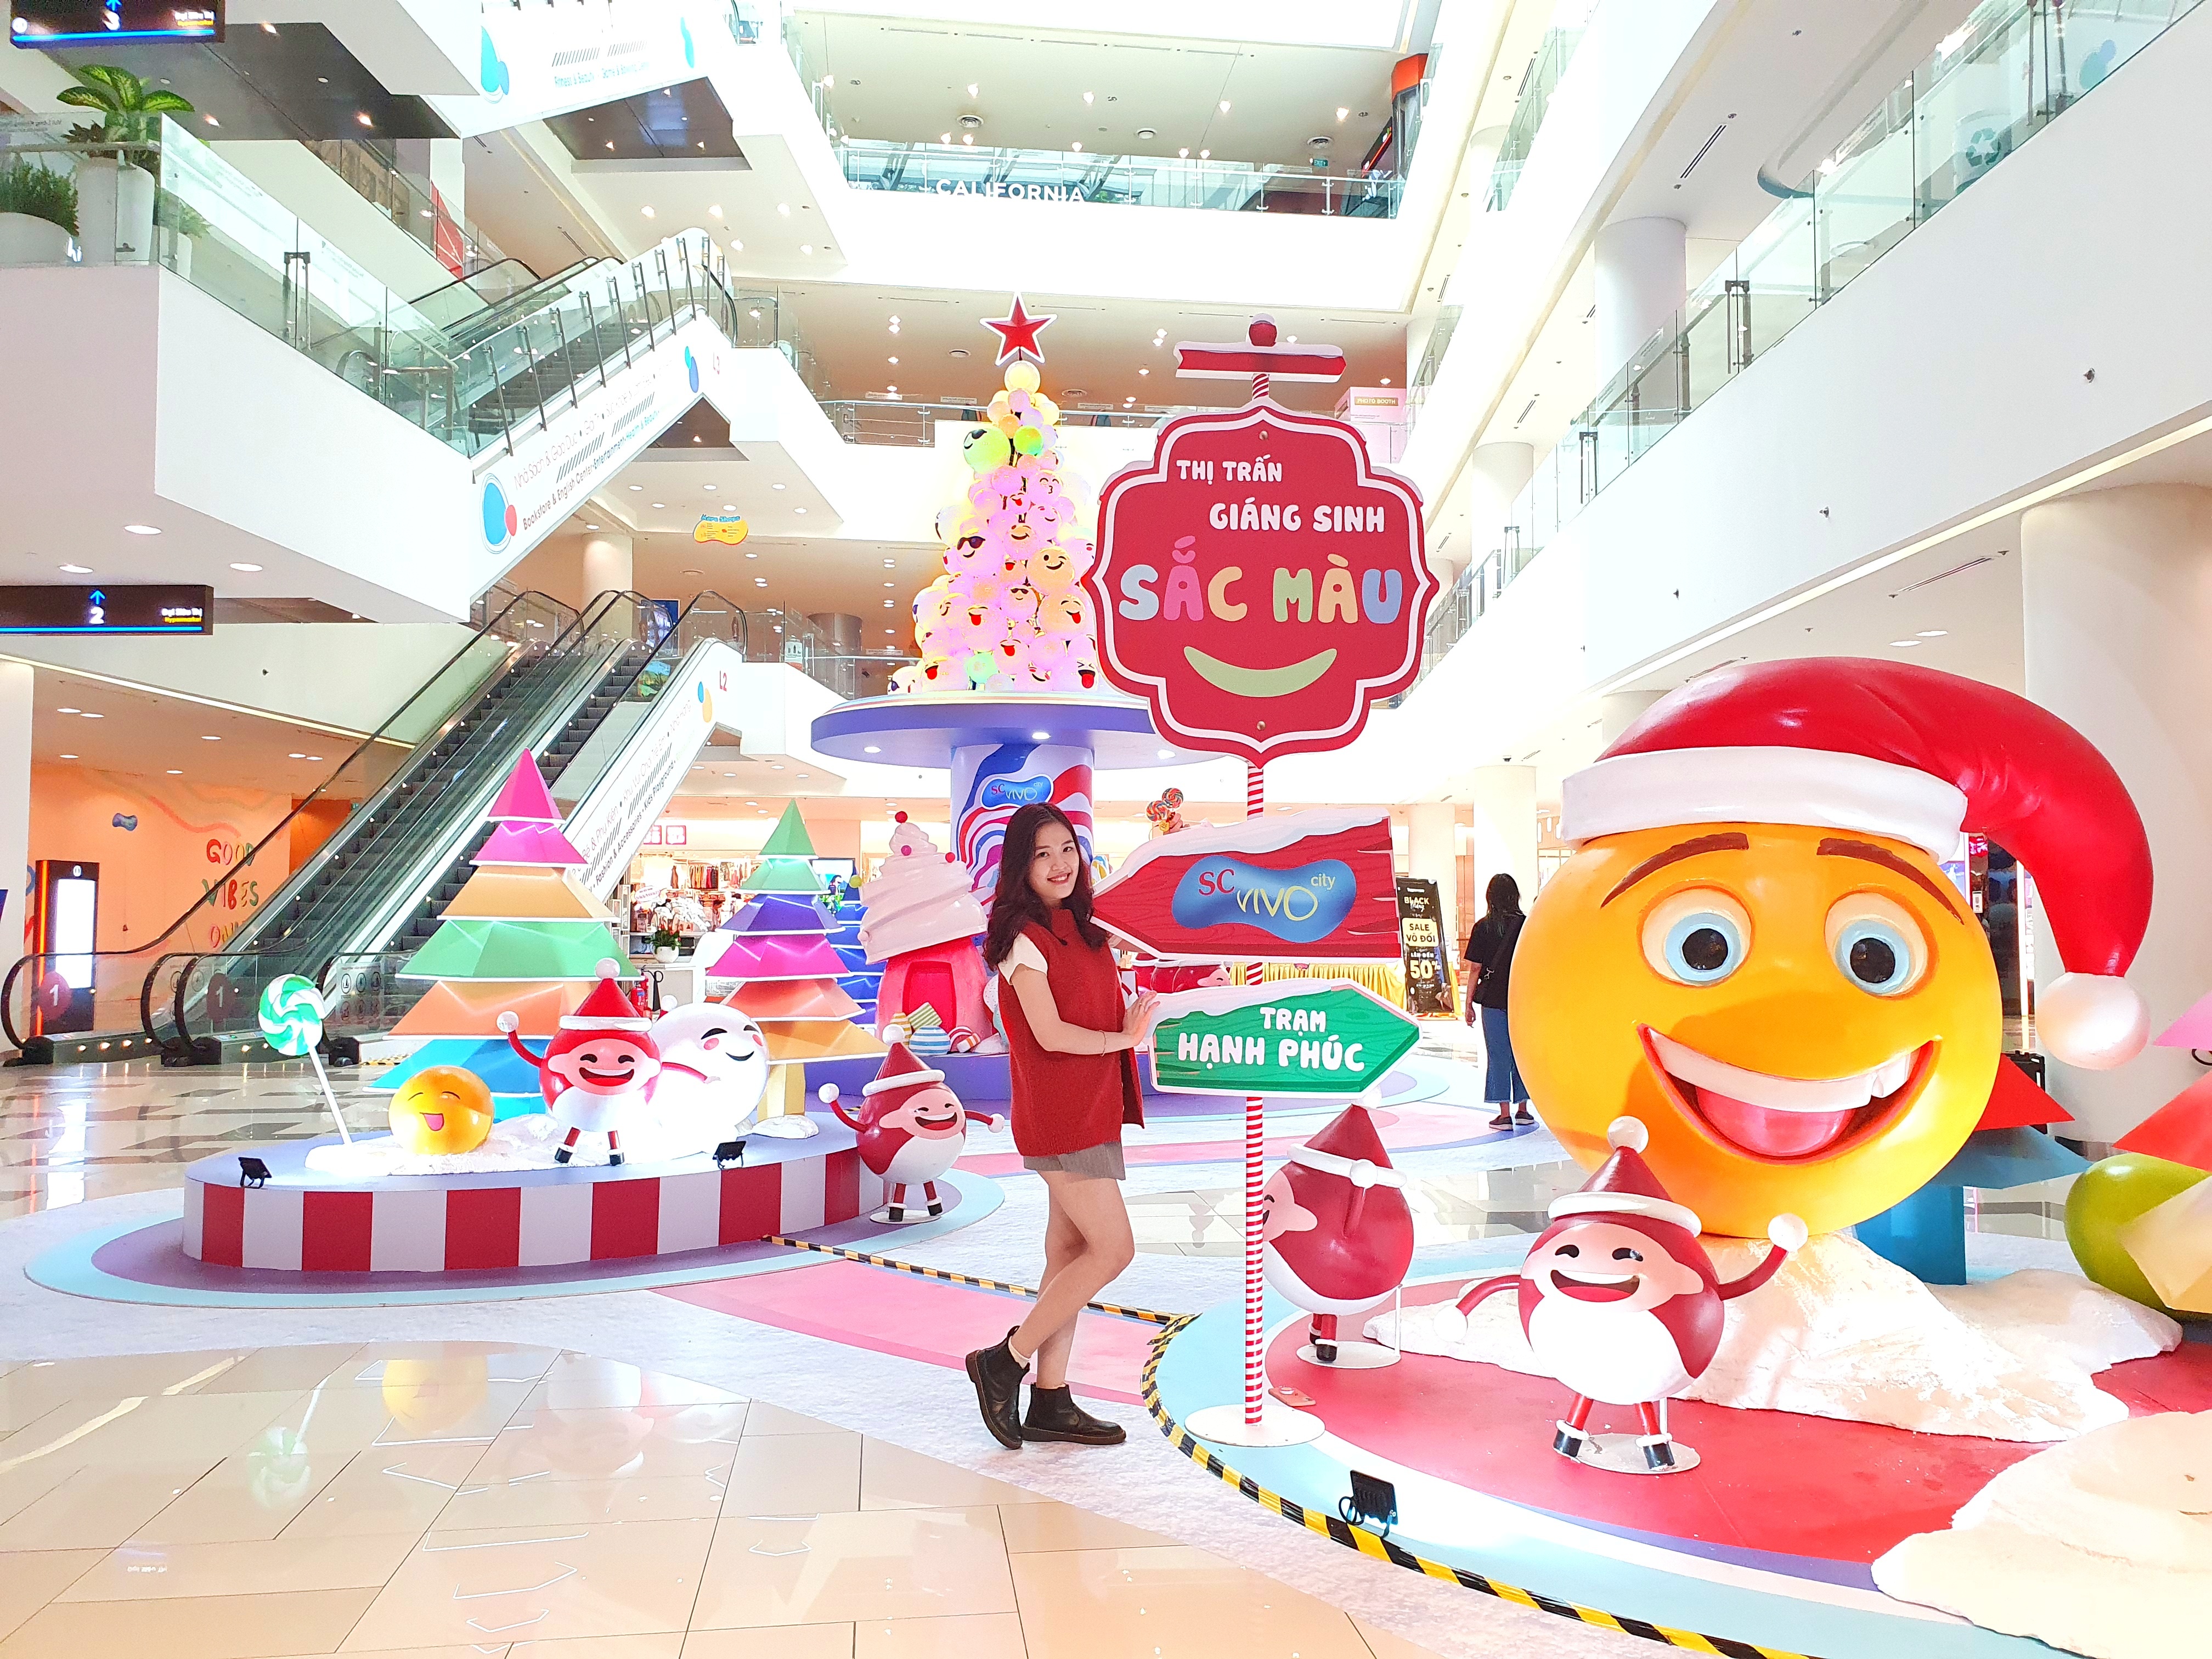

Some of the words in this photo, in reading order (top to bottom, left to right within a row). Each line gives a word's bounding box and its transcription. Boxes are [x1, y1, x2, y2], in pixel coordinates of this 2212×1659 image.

[935, 179, 1086, 203] CALIFORNIA
[1176, 459, 1214, 485] THỊ
[1222, 454, 1283, 482] TRẤN
[523, 499, 551, 531] Bookstore
[552, 493, 557, 505] &
[557, 477, 576, 500] English
[576, 463, 593, 485] Center
[594, 438, 625, 470] Entertainment
[1209, 496, 1302, 531] GIÁNG
[1312, 505, 1385, 533] SINH
[1118, 535, 1248, 622] SẮC
[1272, 553, 1402, 624] MÀU
[90, 607, 104, 624] 2
[719, 670, 727, 692] L2
[991, 783, 1005, 795] SC
[1006, 787, 1037, 801] VIVO
[596, 856, 613, 886] Fashion
[613, 848, 617, 859] &
[618, 811, 642, 854] Accessories
[644, 795, 653, 811] Kids
[653, 763, 674, 797] Playground
[206, 839, 255, 866] GOOD
[201, 879, 259, 910] VIBES
[1198, 869, 1235, 895] SC
[1237, 886, 1318, 921] VIVO
[1311, 873, 1336, 890] city
[1404, 896, 1430, 905] BLACK
[1406, 933, 1417, 942] VÔ
[1420, 932, 1435, 943] ĐỐI
[1410, 960, 1441, 979] 50%
[49, 984, 59, 1007] 1
[216, 985, 224, 1008] 1
[1260, 1007, 1327, 1036] TRẠM
[1178, 1032, 1265, 1070] HẠNH
[1278, 1034, 1365, 1072] PHÚC
